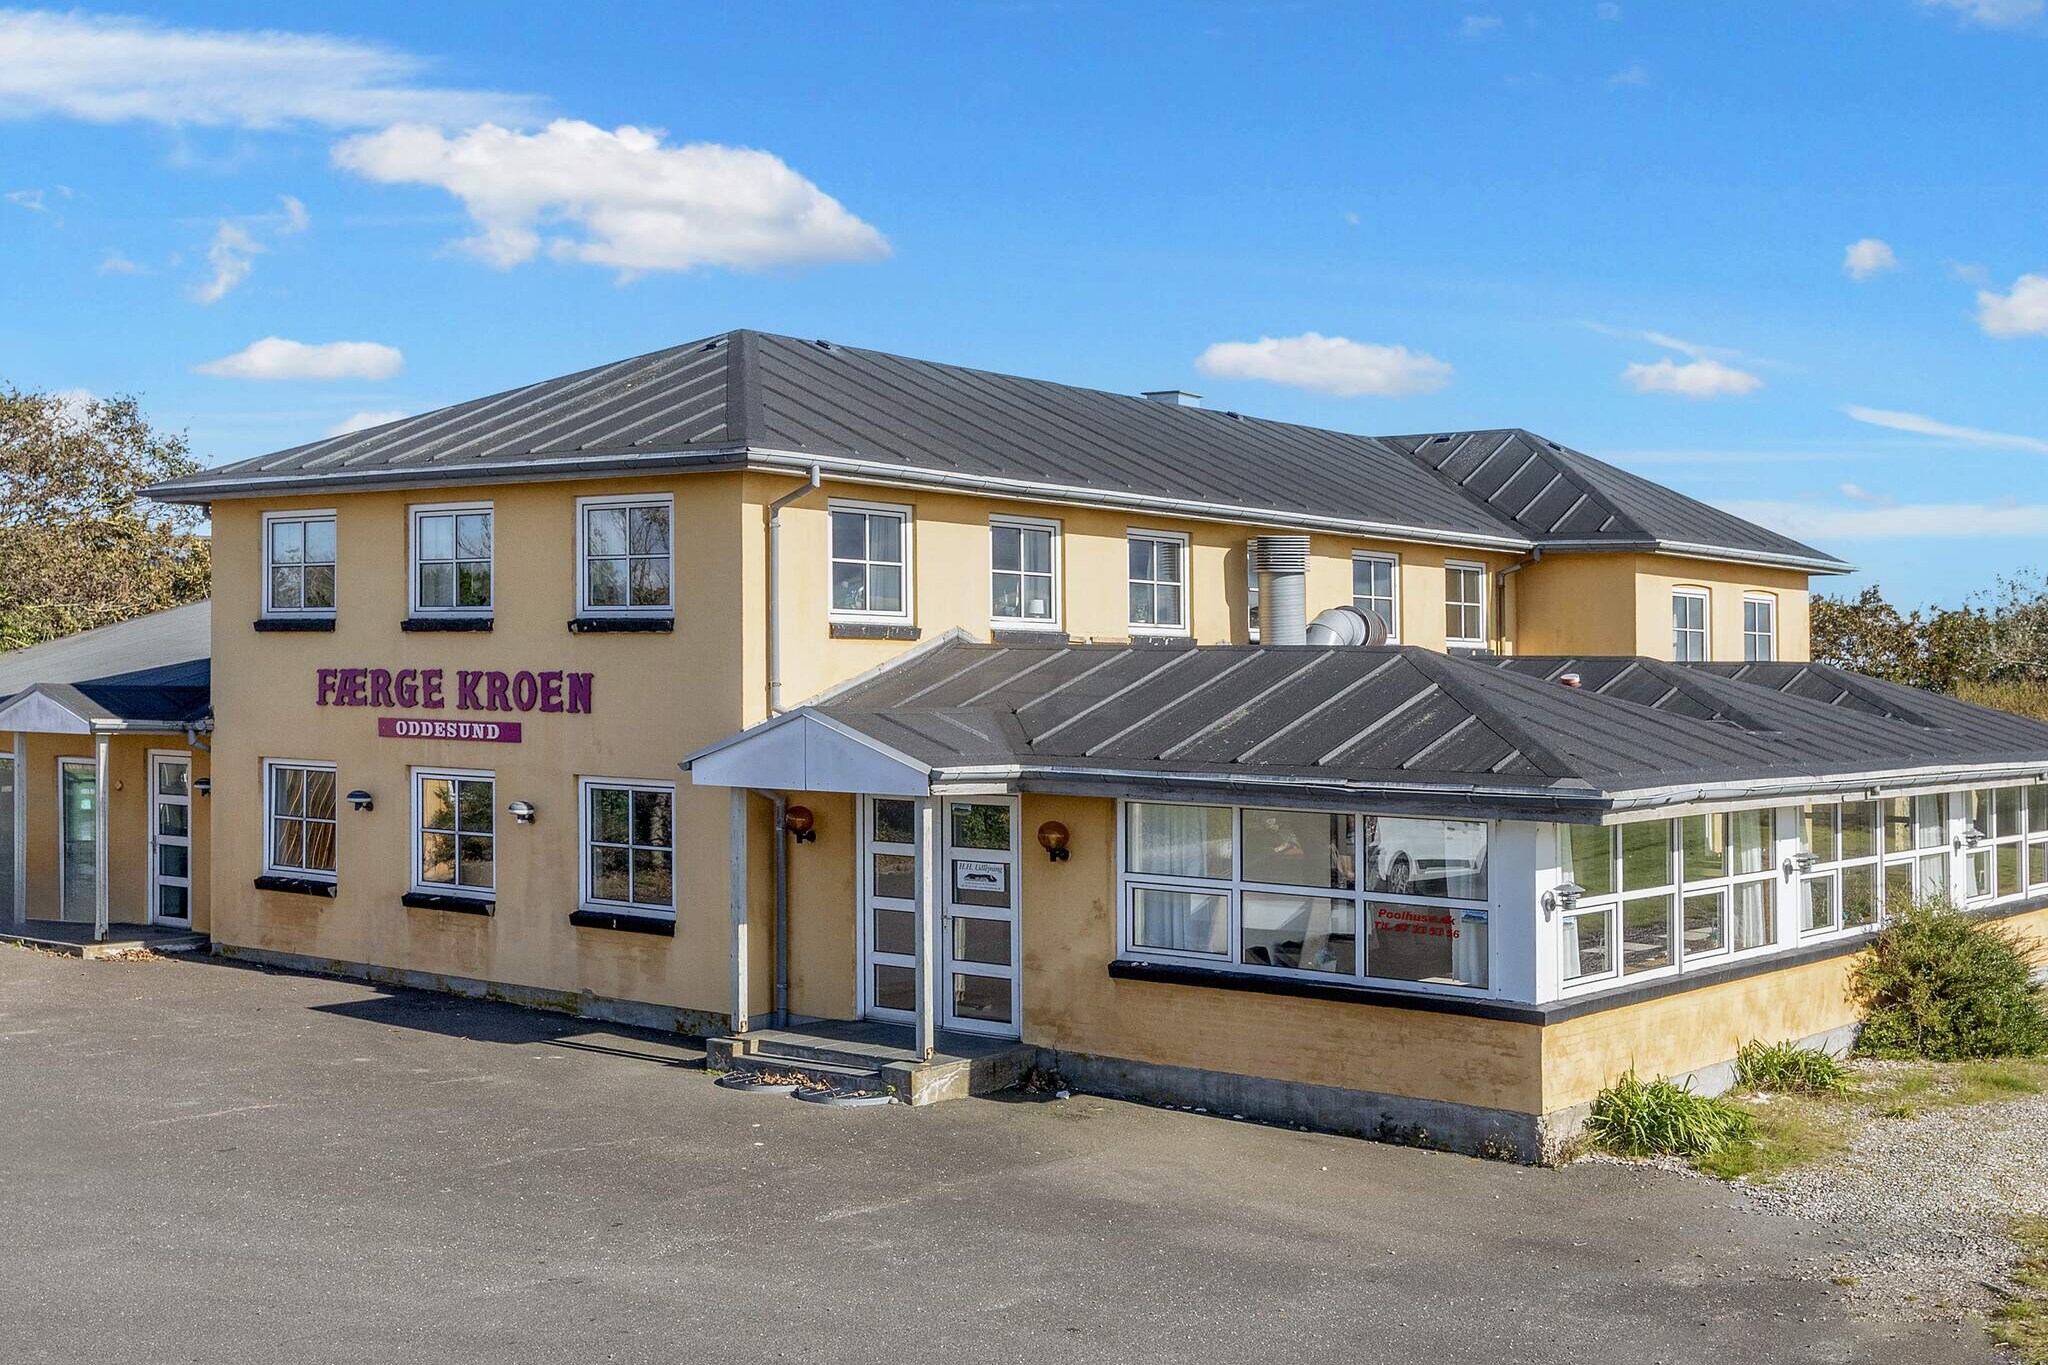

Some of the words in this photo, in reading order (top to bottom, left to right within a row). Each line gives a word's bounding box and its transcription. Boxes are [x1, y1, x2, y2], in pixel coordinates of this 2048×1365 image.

[316, 668, 445, 709] FÆRGE
[456, 670, 594, 714] KROEN
[395, 720, 500, 740] ODDESUND
